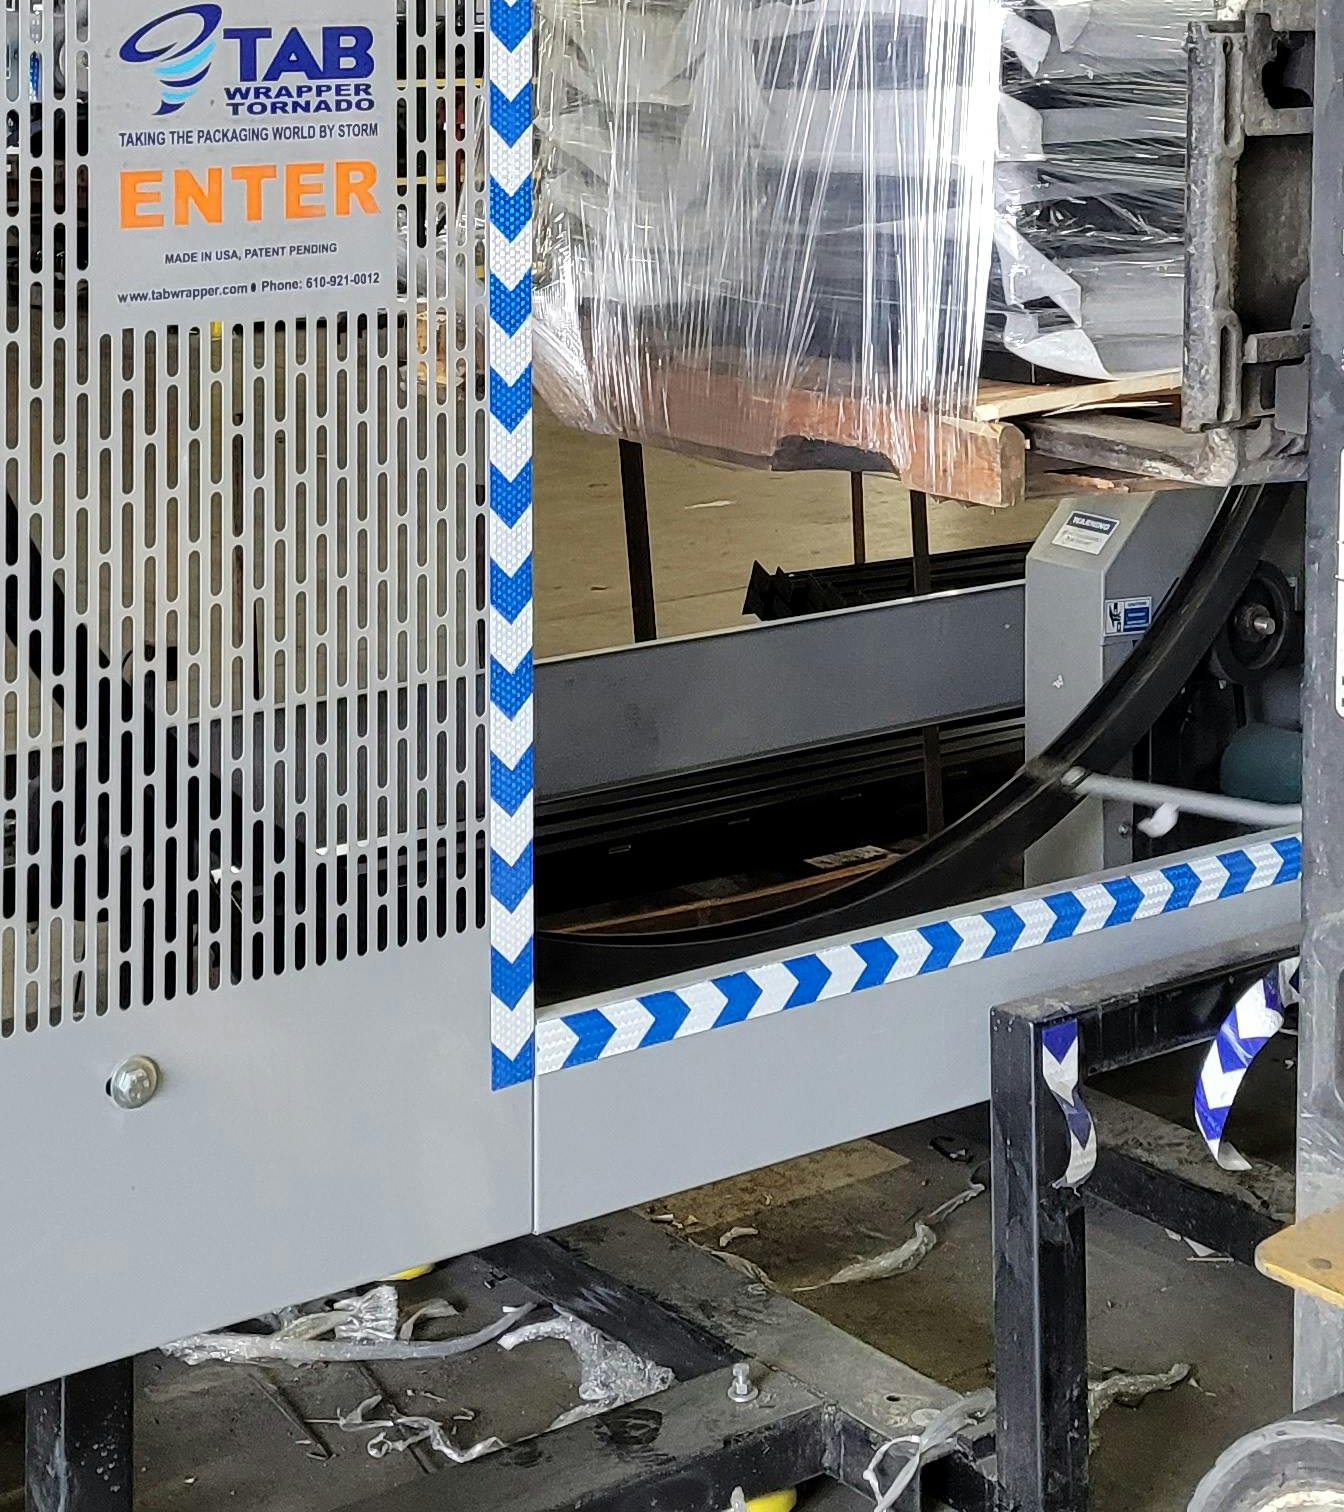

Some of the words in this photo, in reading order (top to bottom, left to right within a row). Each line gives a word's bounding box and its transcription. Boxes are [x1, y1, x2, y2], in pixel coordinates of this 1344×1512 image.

[223, 26, 375, 82] TAB
[224, 83, 373, 101] WRAPPER
[225, 97, 375, 116] TORNADO
[119, 131, 166, 147] TAKING
[169, 129, 194, 145] THE
[197, 127, 269, 144] PACKAGING
[272, 125, 316, 141] WORLD
[319, 124, 336, 138] BY
[338, 122, 378, 138] STORM
[119, 159, 382, 229] ENTER
[164, 251, 198, 264] MADE
[200, 250, 212, 262] IN
[215, 249, 242, 262] USA,
[244, 246, 287, 259] PATENT
[289, 242, 338, 256] PENDING
[117, 283, 248, 304] www.tabwrapper.com
[261, 279, 303, 292] Phone:
[305, 271, 380, 289] 610-921-0012
